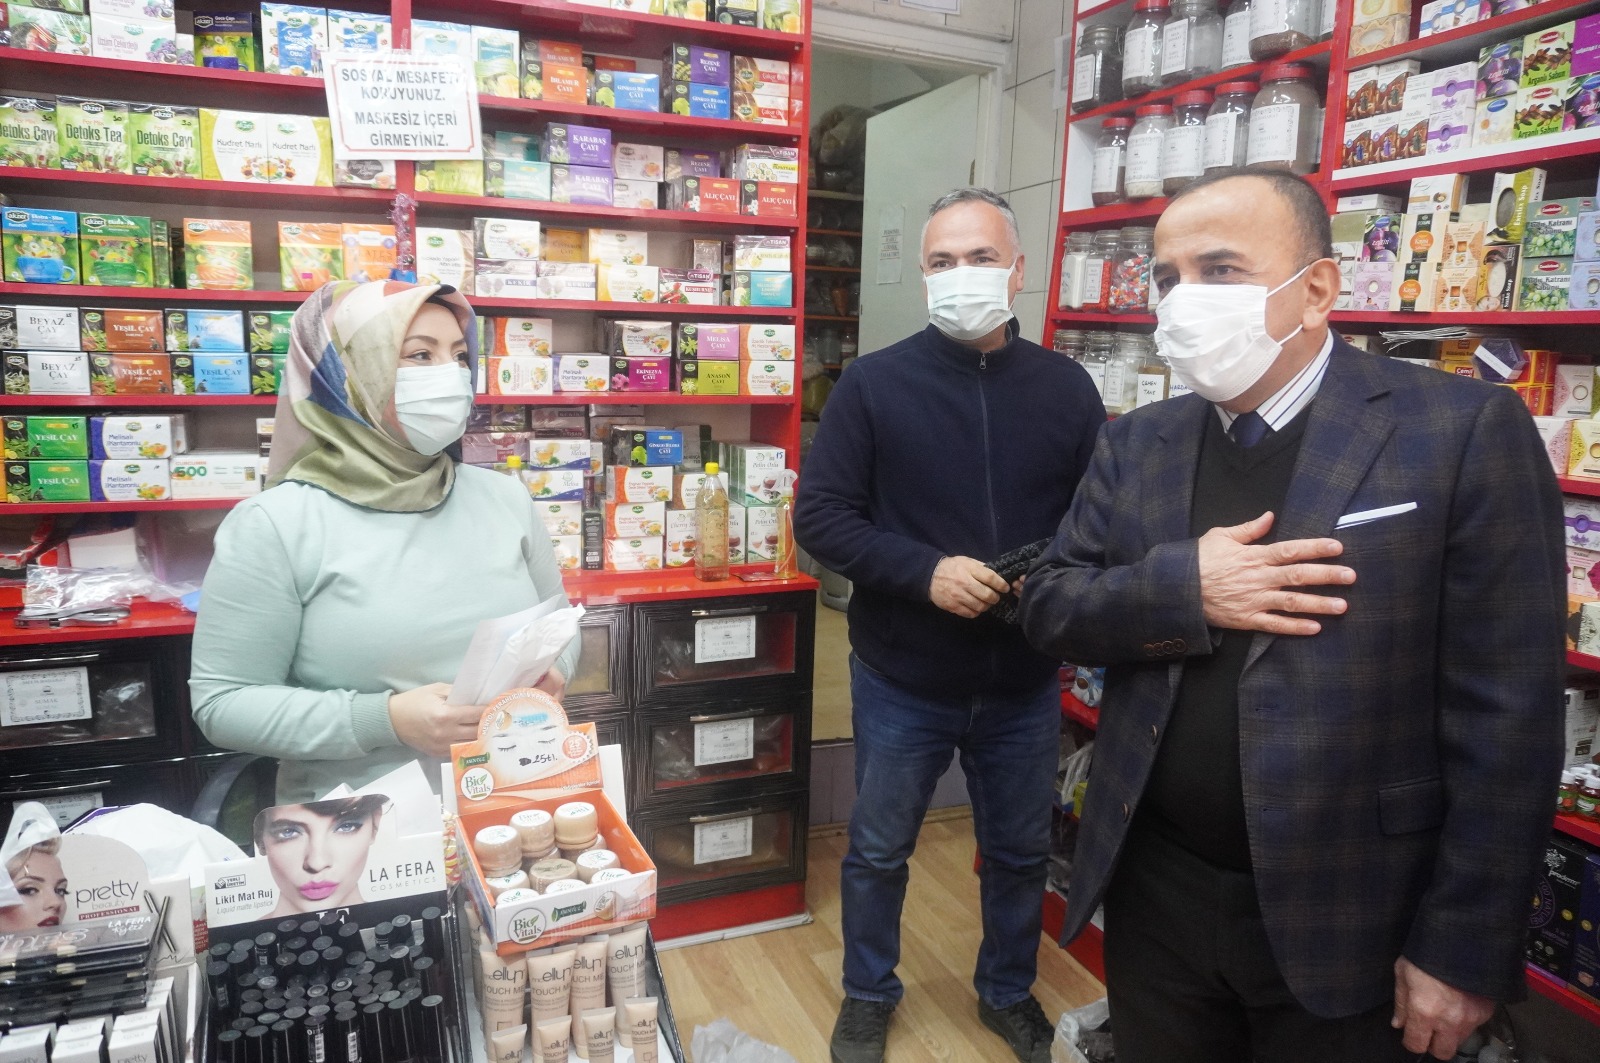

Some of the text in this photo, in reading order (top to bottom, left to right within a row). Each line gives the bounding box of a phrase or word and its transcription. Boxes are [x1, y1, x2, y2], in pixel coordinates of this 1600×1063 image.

[355, 110, 458, 128] MASKESİZ İÇERİ
[66, 124, 122, 143] Detoks Tea
[136, 130, 169, 146] Detoks
[370, 130, 449, 147] GİRMEYİNİZ.
[573, 134, 607, 146] KARABAŞ
[580, 143, 599, 152] ÇAYI
[30, 317, 65, 326] BEYAZ
[38, 325, 57, 335] ÇAY
[138, 325, 156, 333] ÇAY
[41, 362, 77, 371] BEYAZ
[50, 371, 69, 380] ÇAY
[224, 369, 242, 377] ÇAY
[35, 433, 78, 443] YEŞİL ÇAY
[174, 466, 208, 478] 500
[38, 477, 81, 486] YEŞİL ÇAY
[465, 775, 482, 786] Bio
[466, 784, 491, 795] Vitals
[369, 859, 436, 883] LA FERA
[370, 875, 437, 893] COSMETICS
[75, 879, 139, 909] pretty
[215, 888, 273, 905] Likit Mat Ruj
[91, 899, 125, 910] beauty
[216, 899, 274, 915] Liquid matte lipstick
[80, 906, 139, 920] PROFESSIONAL
[513, 918, 532, 931] Bio
[514, 926, 542, 937] Vitals
[532, 985, 561, 996] TOUCH
